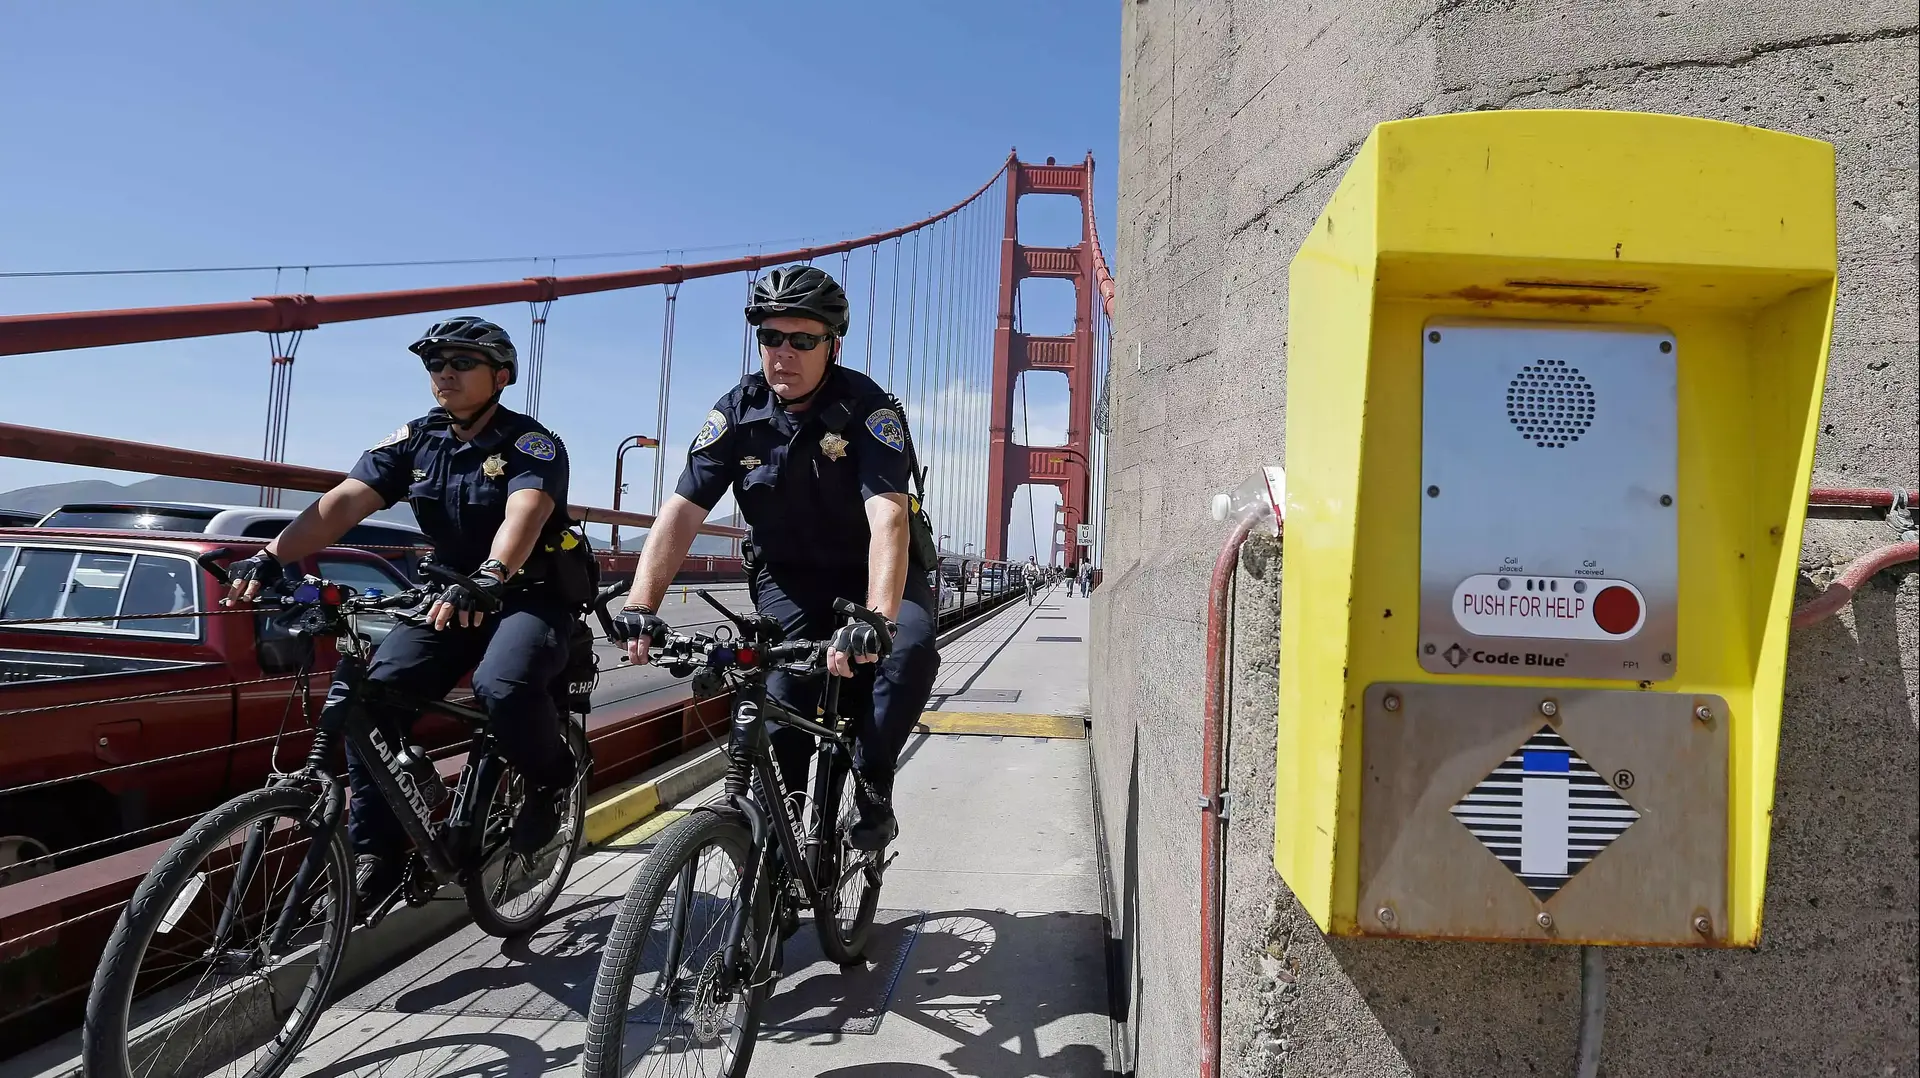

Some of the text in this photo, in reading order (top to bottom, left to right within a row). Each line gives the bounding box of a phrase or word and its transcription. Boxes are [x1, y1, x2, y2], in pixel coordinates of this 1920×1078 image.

[1504, 556, 1519, 565] Call
[1582, 560, 1597, 568] Call
[1499, 565, 1523, 573] placed
[1574, 568, 1605, 576] received
[1463, 593, 1585, 619] PUSH FOR HELP
[1472, 650, 1520, 665] Code
[1622, 660, 1640, 670] FP1
